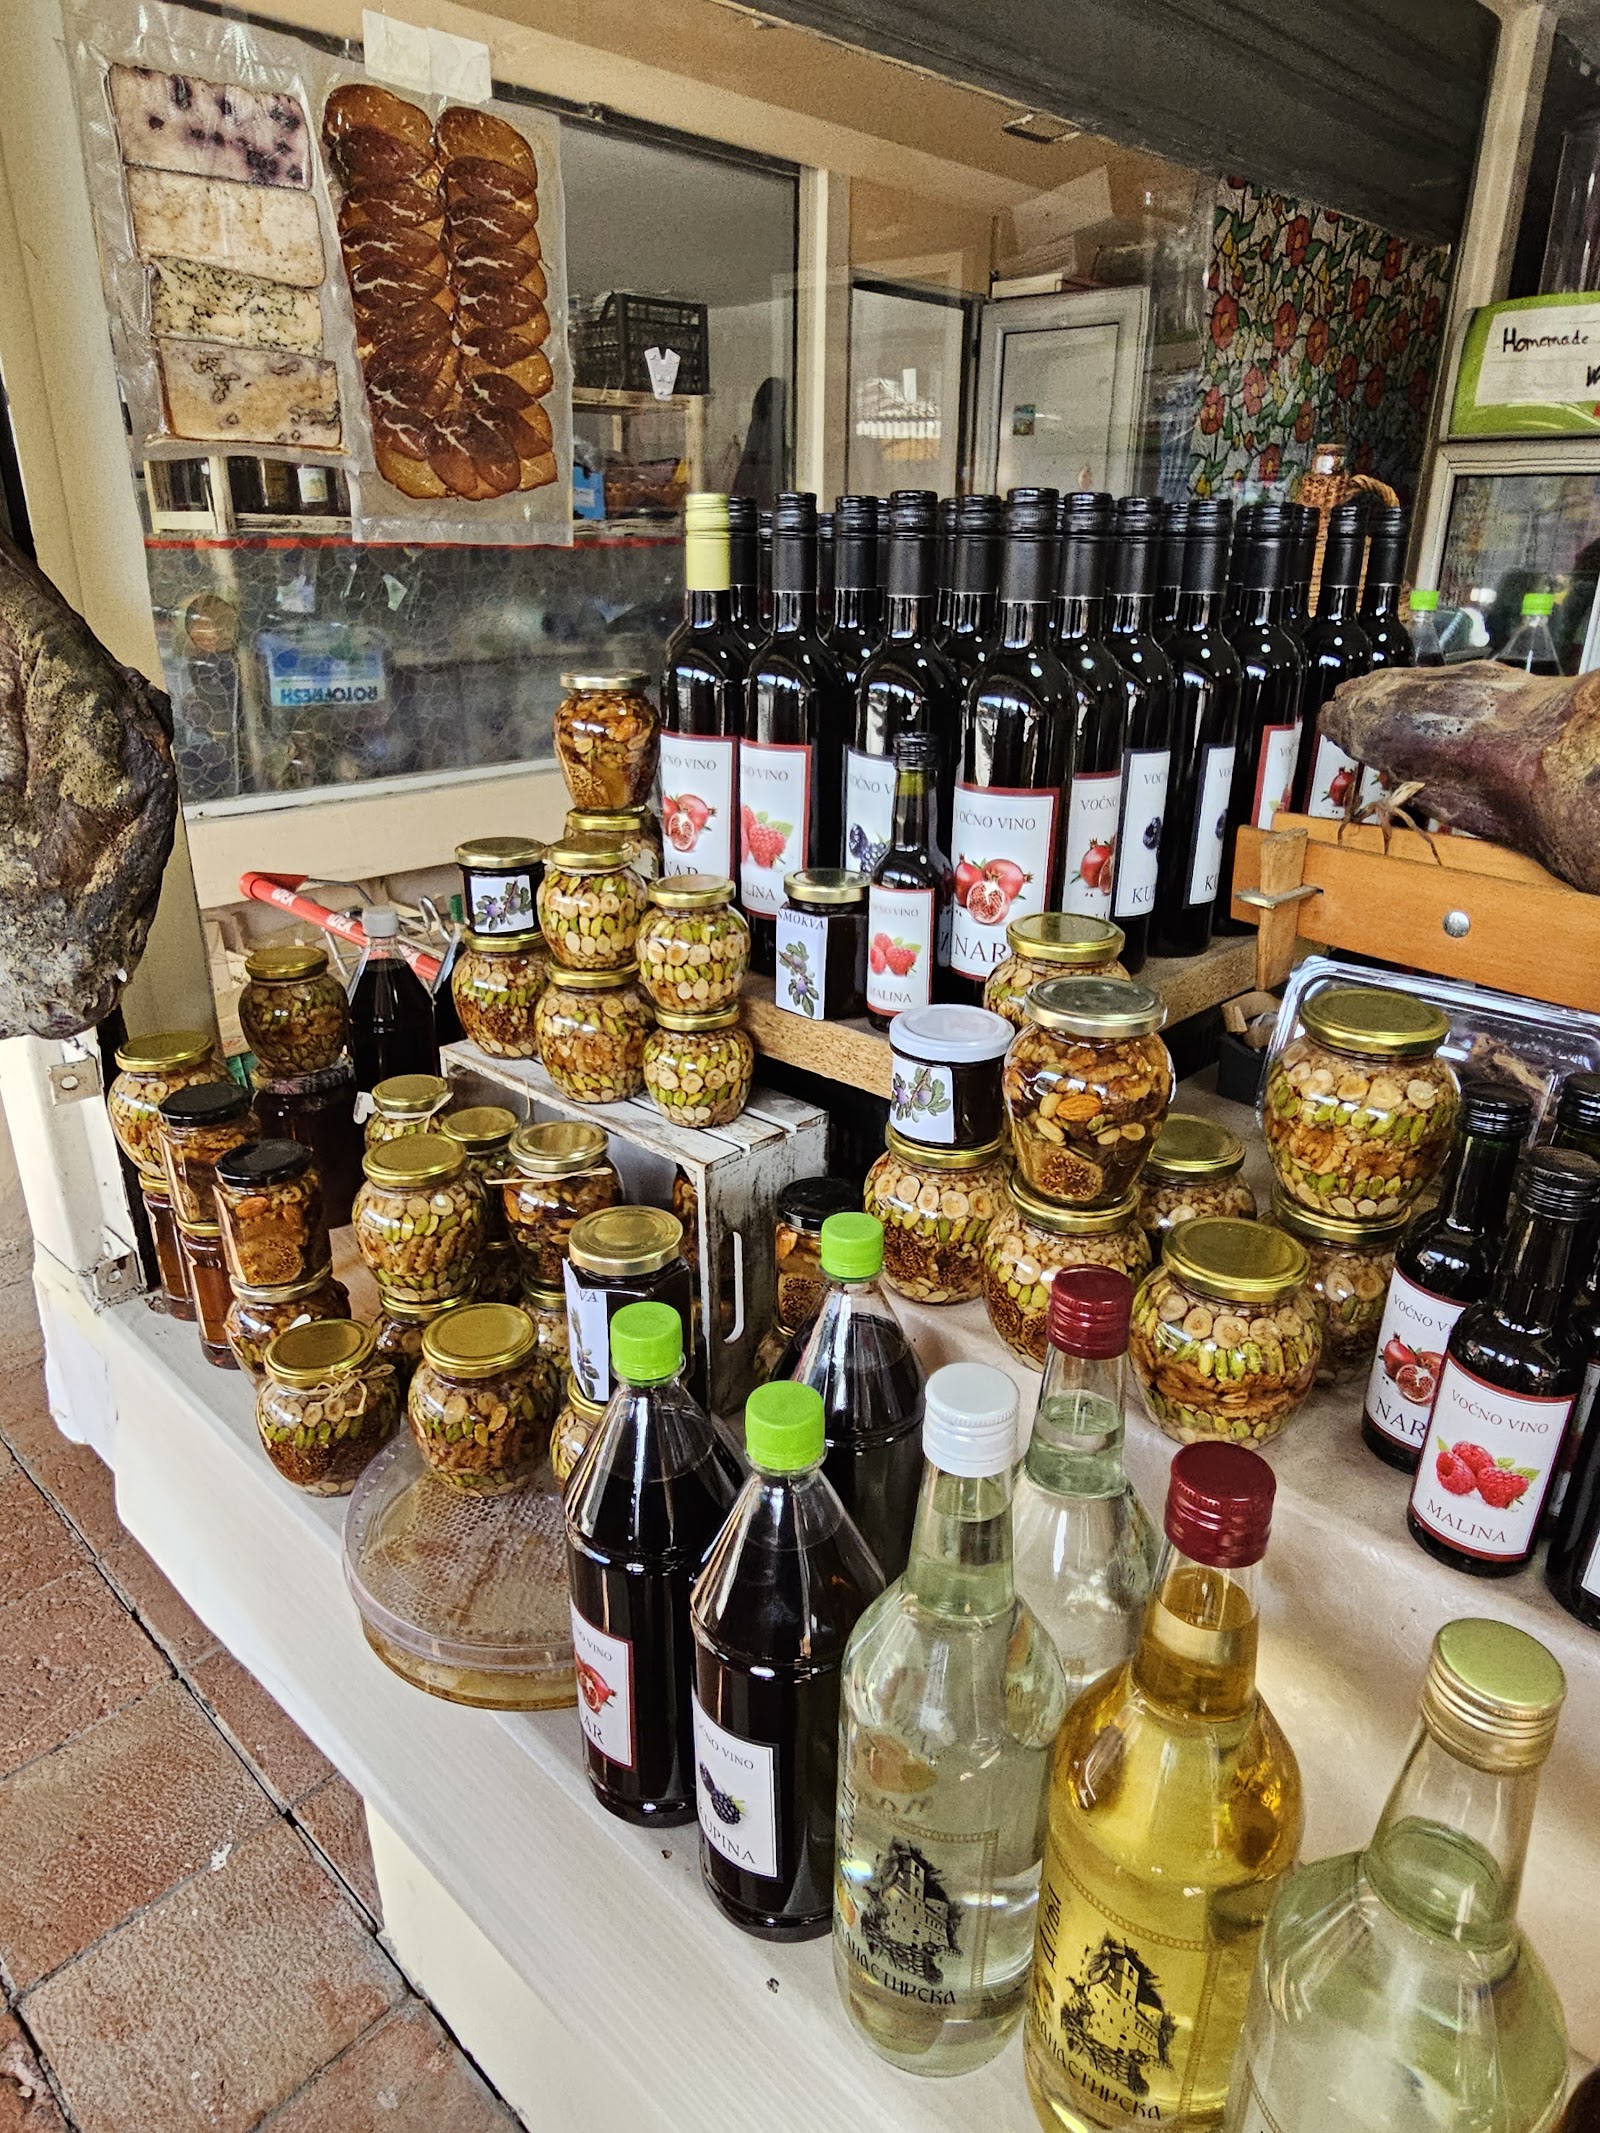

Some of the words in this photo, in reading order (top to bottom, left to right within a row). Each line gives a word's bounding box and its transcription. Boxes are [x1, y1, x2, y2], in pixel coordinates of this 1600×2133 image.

[1502, 327, 1590, 353] Homemade
[684, 758, 717, 771] VINO
[756, 767, 789, 782] VINO
[997, 817, 1035, 831] VINO
[777, 910, 825, 930] SMOKVA
[893, 907, 919, 918] VINO
[954, 933, 1007, 963] NAR
[1437, 1321, 1452, 1332] V
[1377, 1397, 1425, 1440] NAR
[1508, 1418, 1550, 1435] VINO
[1426, 1498, 1507, 1544] MALINA
[586, 1637, 614, 1662] VINO
[721, 1746, 754, 1770] VINO
